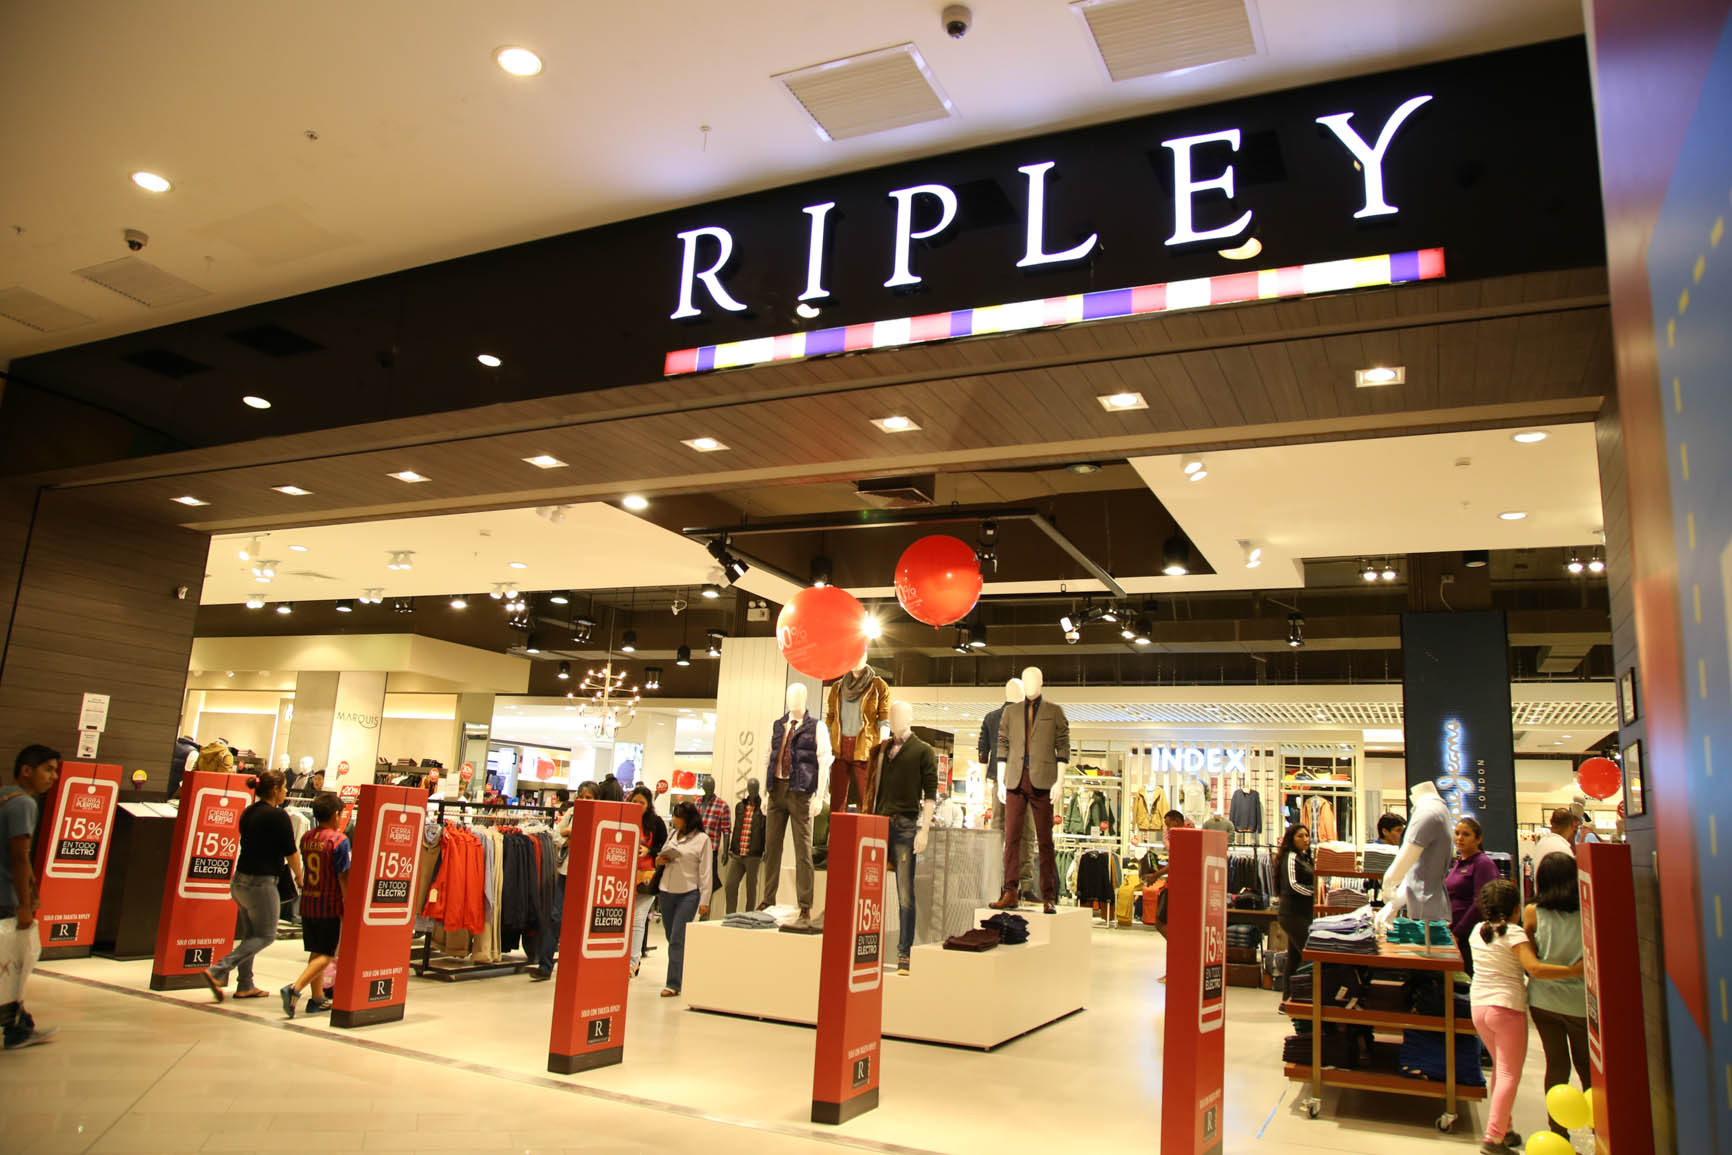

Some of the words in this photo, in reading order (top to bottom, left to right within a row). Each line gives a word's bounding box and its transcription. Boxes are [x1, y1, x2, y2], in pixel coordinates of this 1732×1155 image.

[670, 95, 1433, 320] RIPLEY
[337, 712, 378, 729] MARQUIS
[1151, 748, 1246, 773] INDEX
[1477, 759, 1487, 810] LONDON
[64, 817, 102, 839] 15%
[75, 841, 96, 849] TODO
[196, 832, 236, 856] 15%
[61, 848, 95, 856] ELECTRO
[193, 866, 228, 874] ELECTRO
[195, 858, 206, 866] EN
[207, 859, 229, 867] TODO
[307, 852, 320, 886] 9
[379, 852, 412, 878] 15%
[389, 881, 407, 889] TODO
[596, 875, 628, 904] 15%
[377, 889, 406, 897] ELECTRO
[596, 908, 604, 917] EN
[606, 908, 623, 917] TODO
[858, 899, 880, 931] 15%
[594, 917, 622, 926] ELECTRO
[59, 924, 69, 936] R
[858, 936, 864, 945] EN
[866, 935, 878, 944] TODO
[1205, 926, 1223, 963] 15%
[192, 949, 203, 962] R
[857, 944, 877, 956] ELECTRO
[376, 980, 385, 995] R
[595, 1021, 603, 1036] R
[858, 1061, 864, 1079] R
